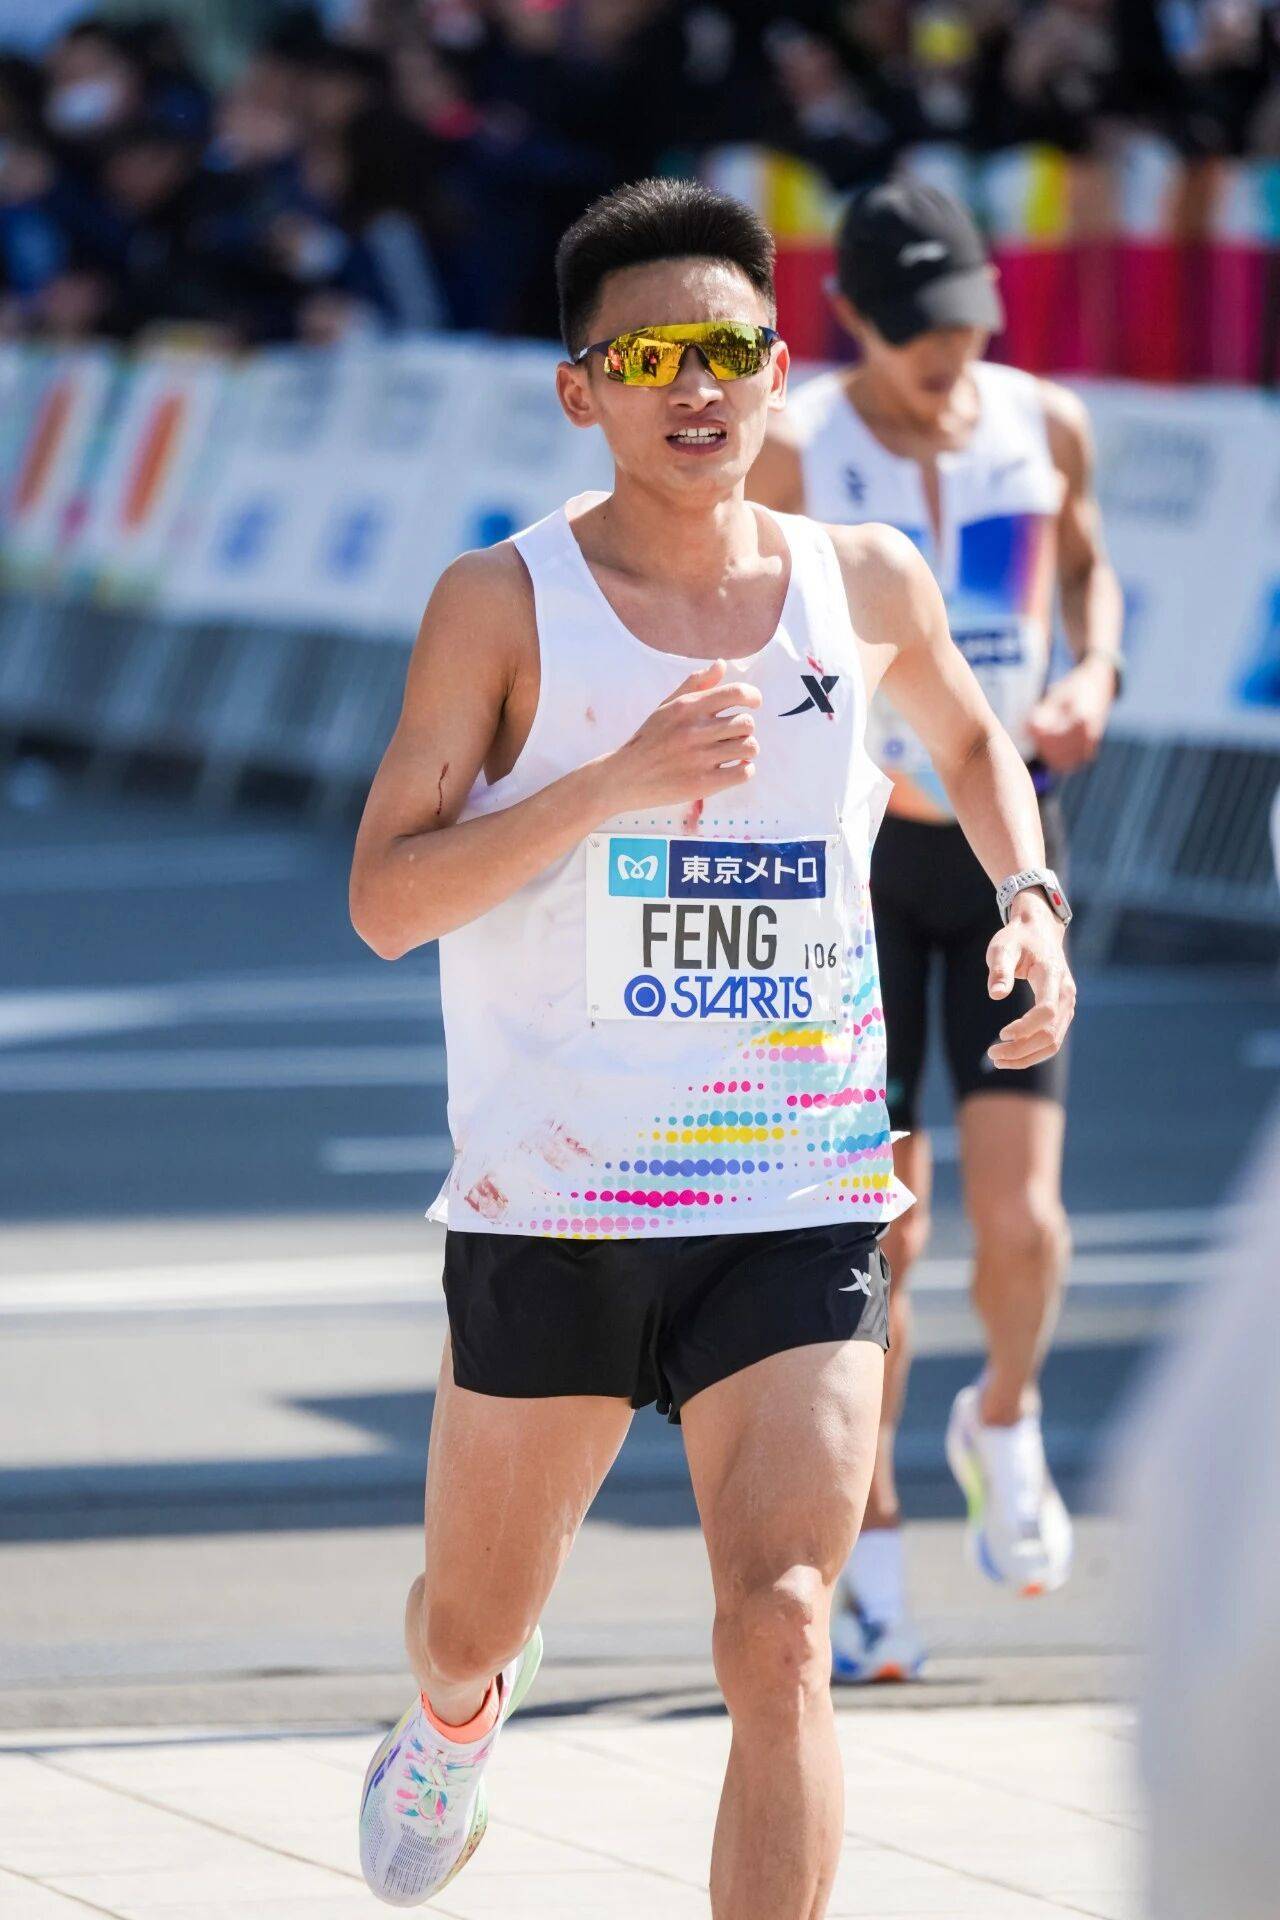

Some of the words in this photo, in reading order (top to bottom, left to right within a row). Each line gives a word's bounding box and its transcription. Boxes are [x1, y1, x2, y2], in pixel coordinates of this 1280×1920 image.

[681, 855, 818, 885] 東京メトロ
[642, 903, 778, 970] FENG
[804, 942, 837, 970] 106
